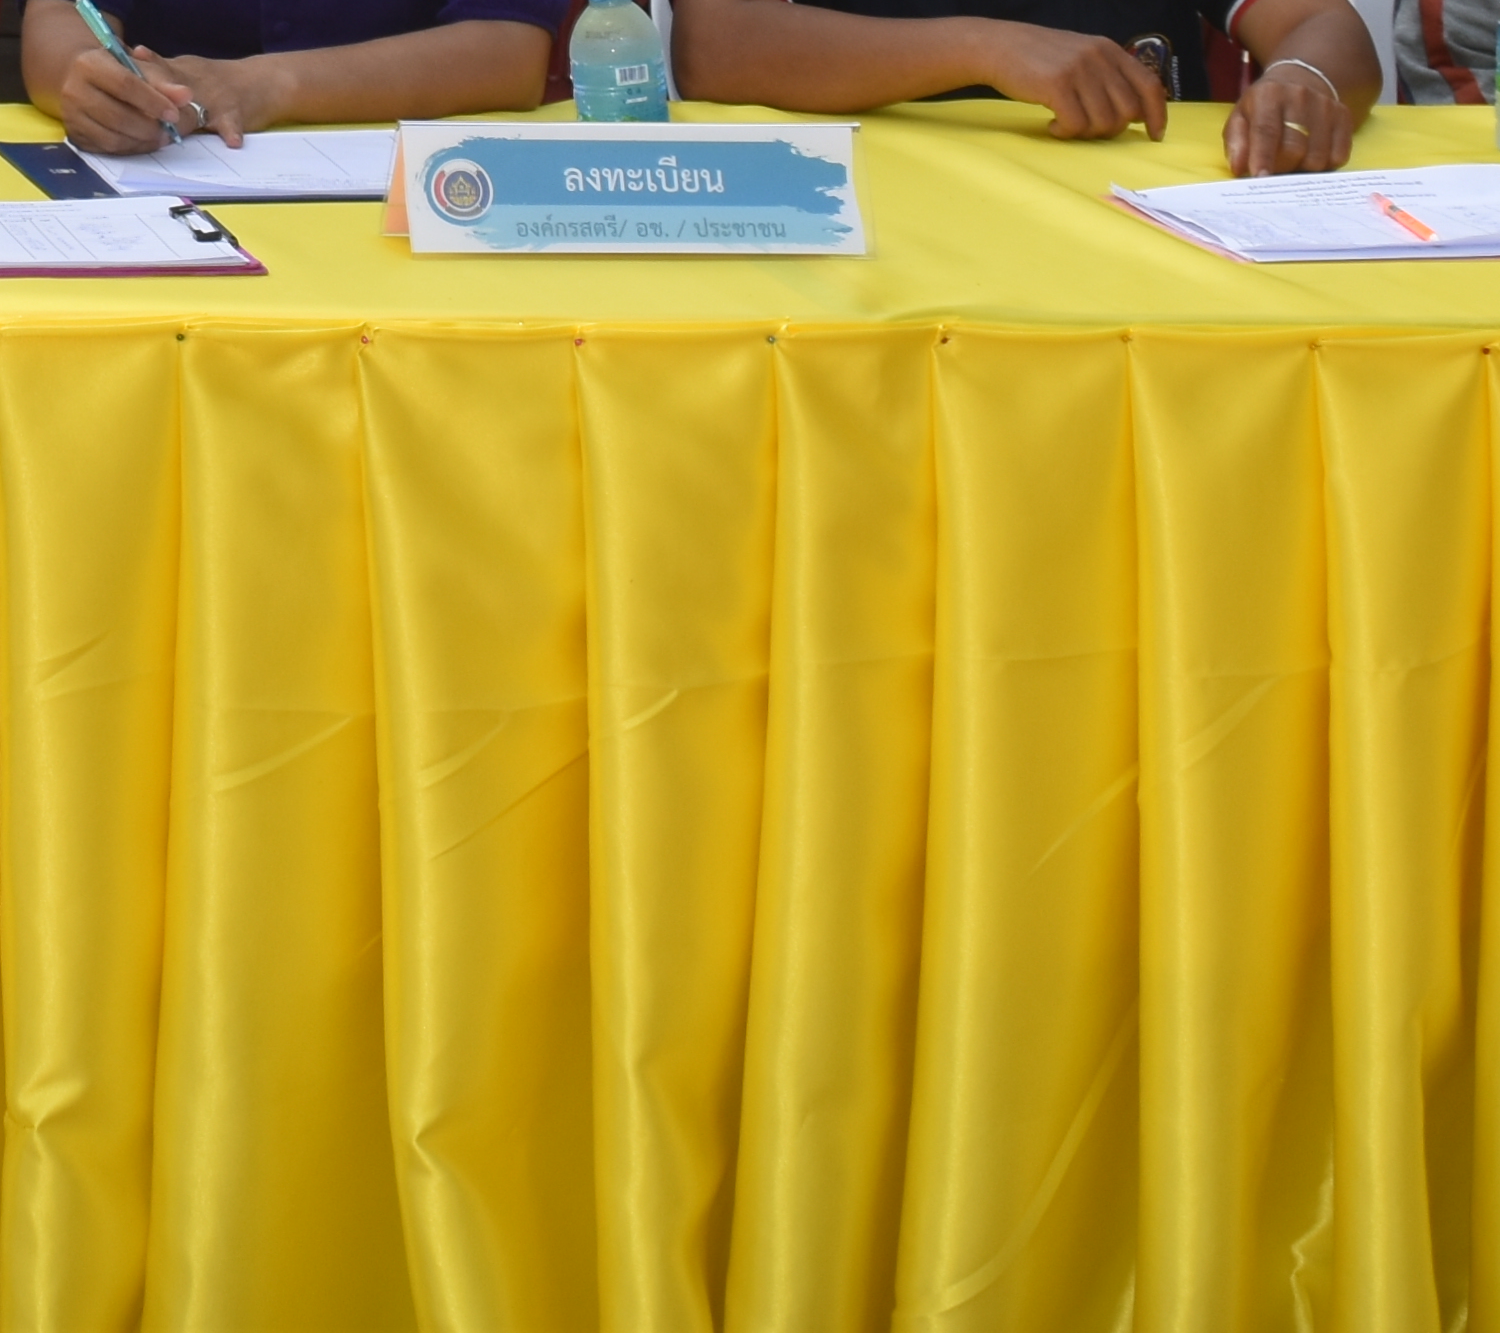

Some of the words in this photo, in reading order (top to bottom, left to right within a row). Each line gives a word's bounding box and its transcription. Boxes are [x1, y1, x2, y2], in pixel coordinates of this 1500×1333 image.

[564, 155, 725, 193] ลงทะเบียน
[694, 217, 786, 239] ประชาชน
